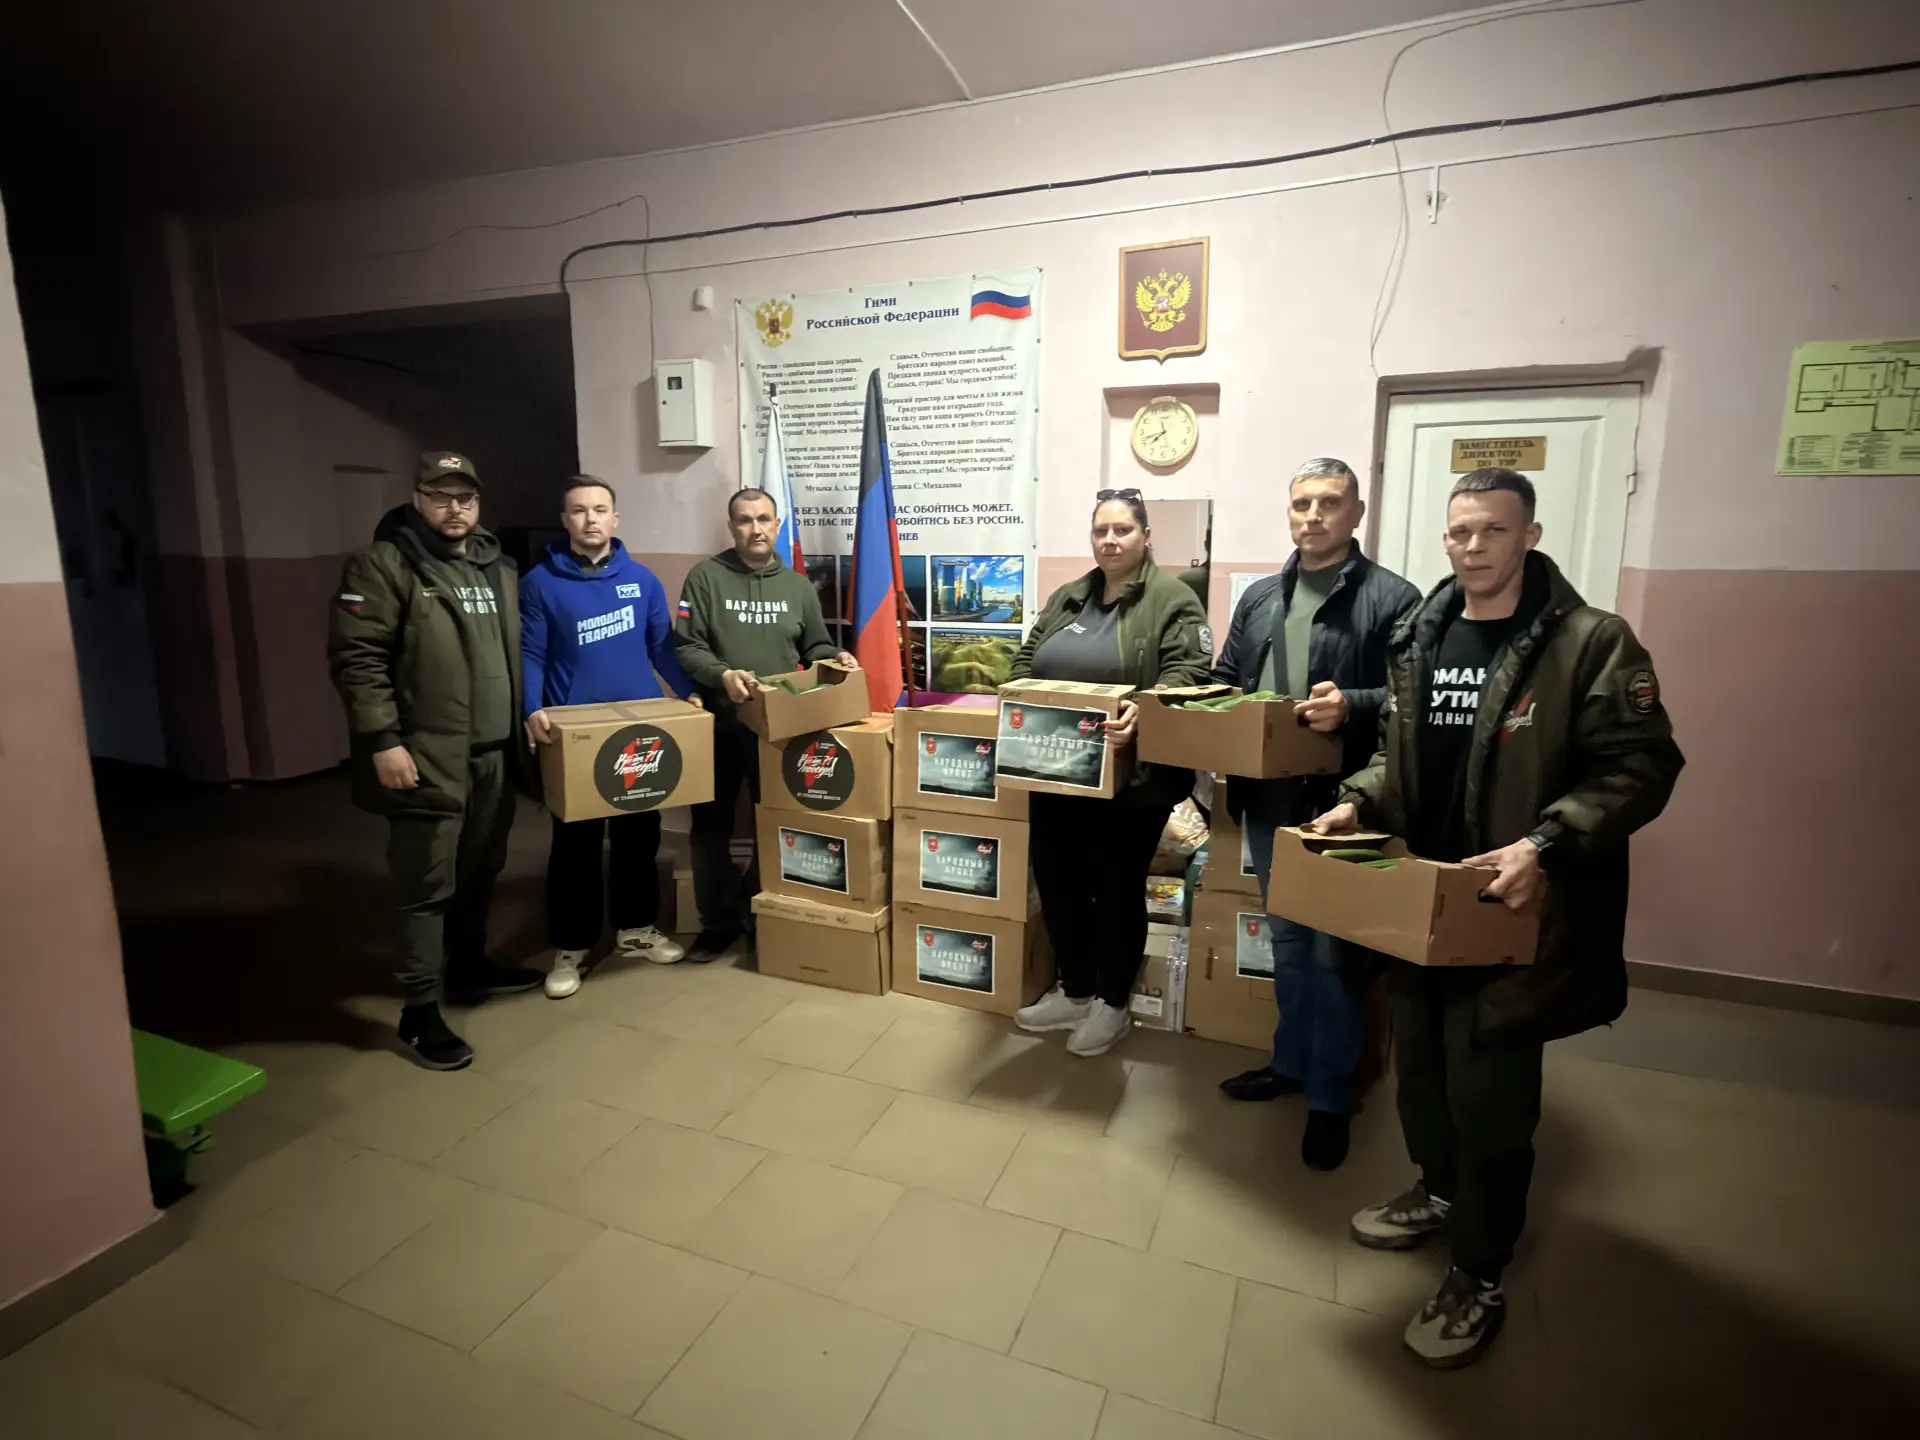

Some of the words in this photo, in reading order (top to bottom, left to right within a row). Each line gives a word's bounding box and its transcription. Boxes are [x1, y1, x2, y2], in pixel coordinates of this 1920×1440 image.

[864, 296, 897, 309] Гимн
[806, 314, 880, 330] Российской
[883, 307, 960, 323] Федерации
[801, 506, 820, 514] БЕЗ
[823, 506, 859, 514] КАЖДО
[913, 502, 969, 513] ОБОЙТИСЬ
[973, 503, 1014, 512] МОЖЕТ.
[803, 517, 816, 526] ИЗ
[818, 517, 839, 526] НАС
[841, 517, 855, 526] НЕ
[896, 515, 950, 525] ОБОЙТИСЬ
[953, 516, 974, 525] БЕЗ
[977, 515, 1024, 525] РОССИИ.
[725, 599, 788, 613] НАРОДНЫЙ
[738, 612, 778, 624] ФРОНТ
